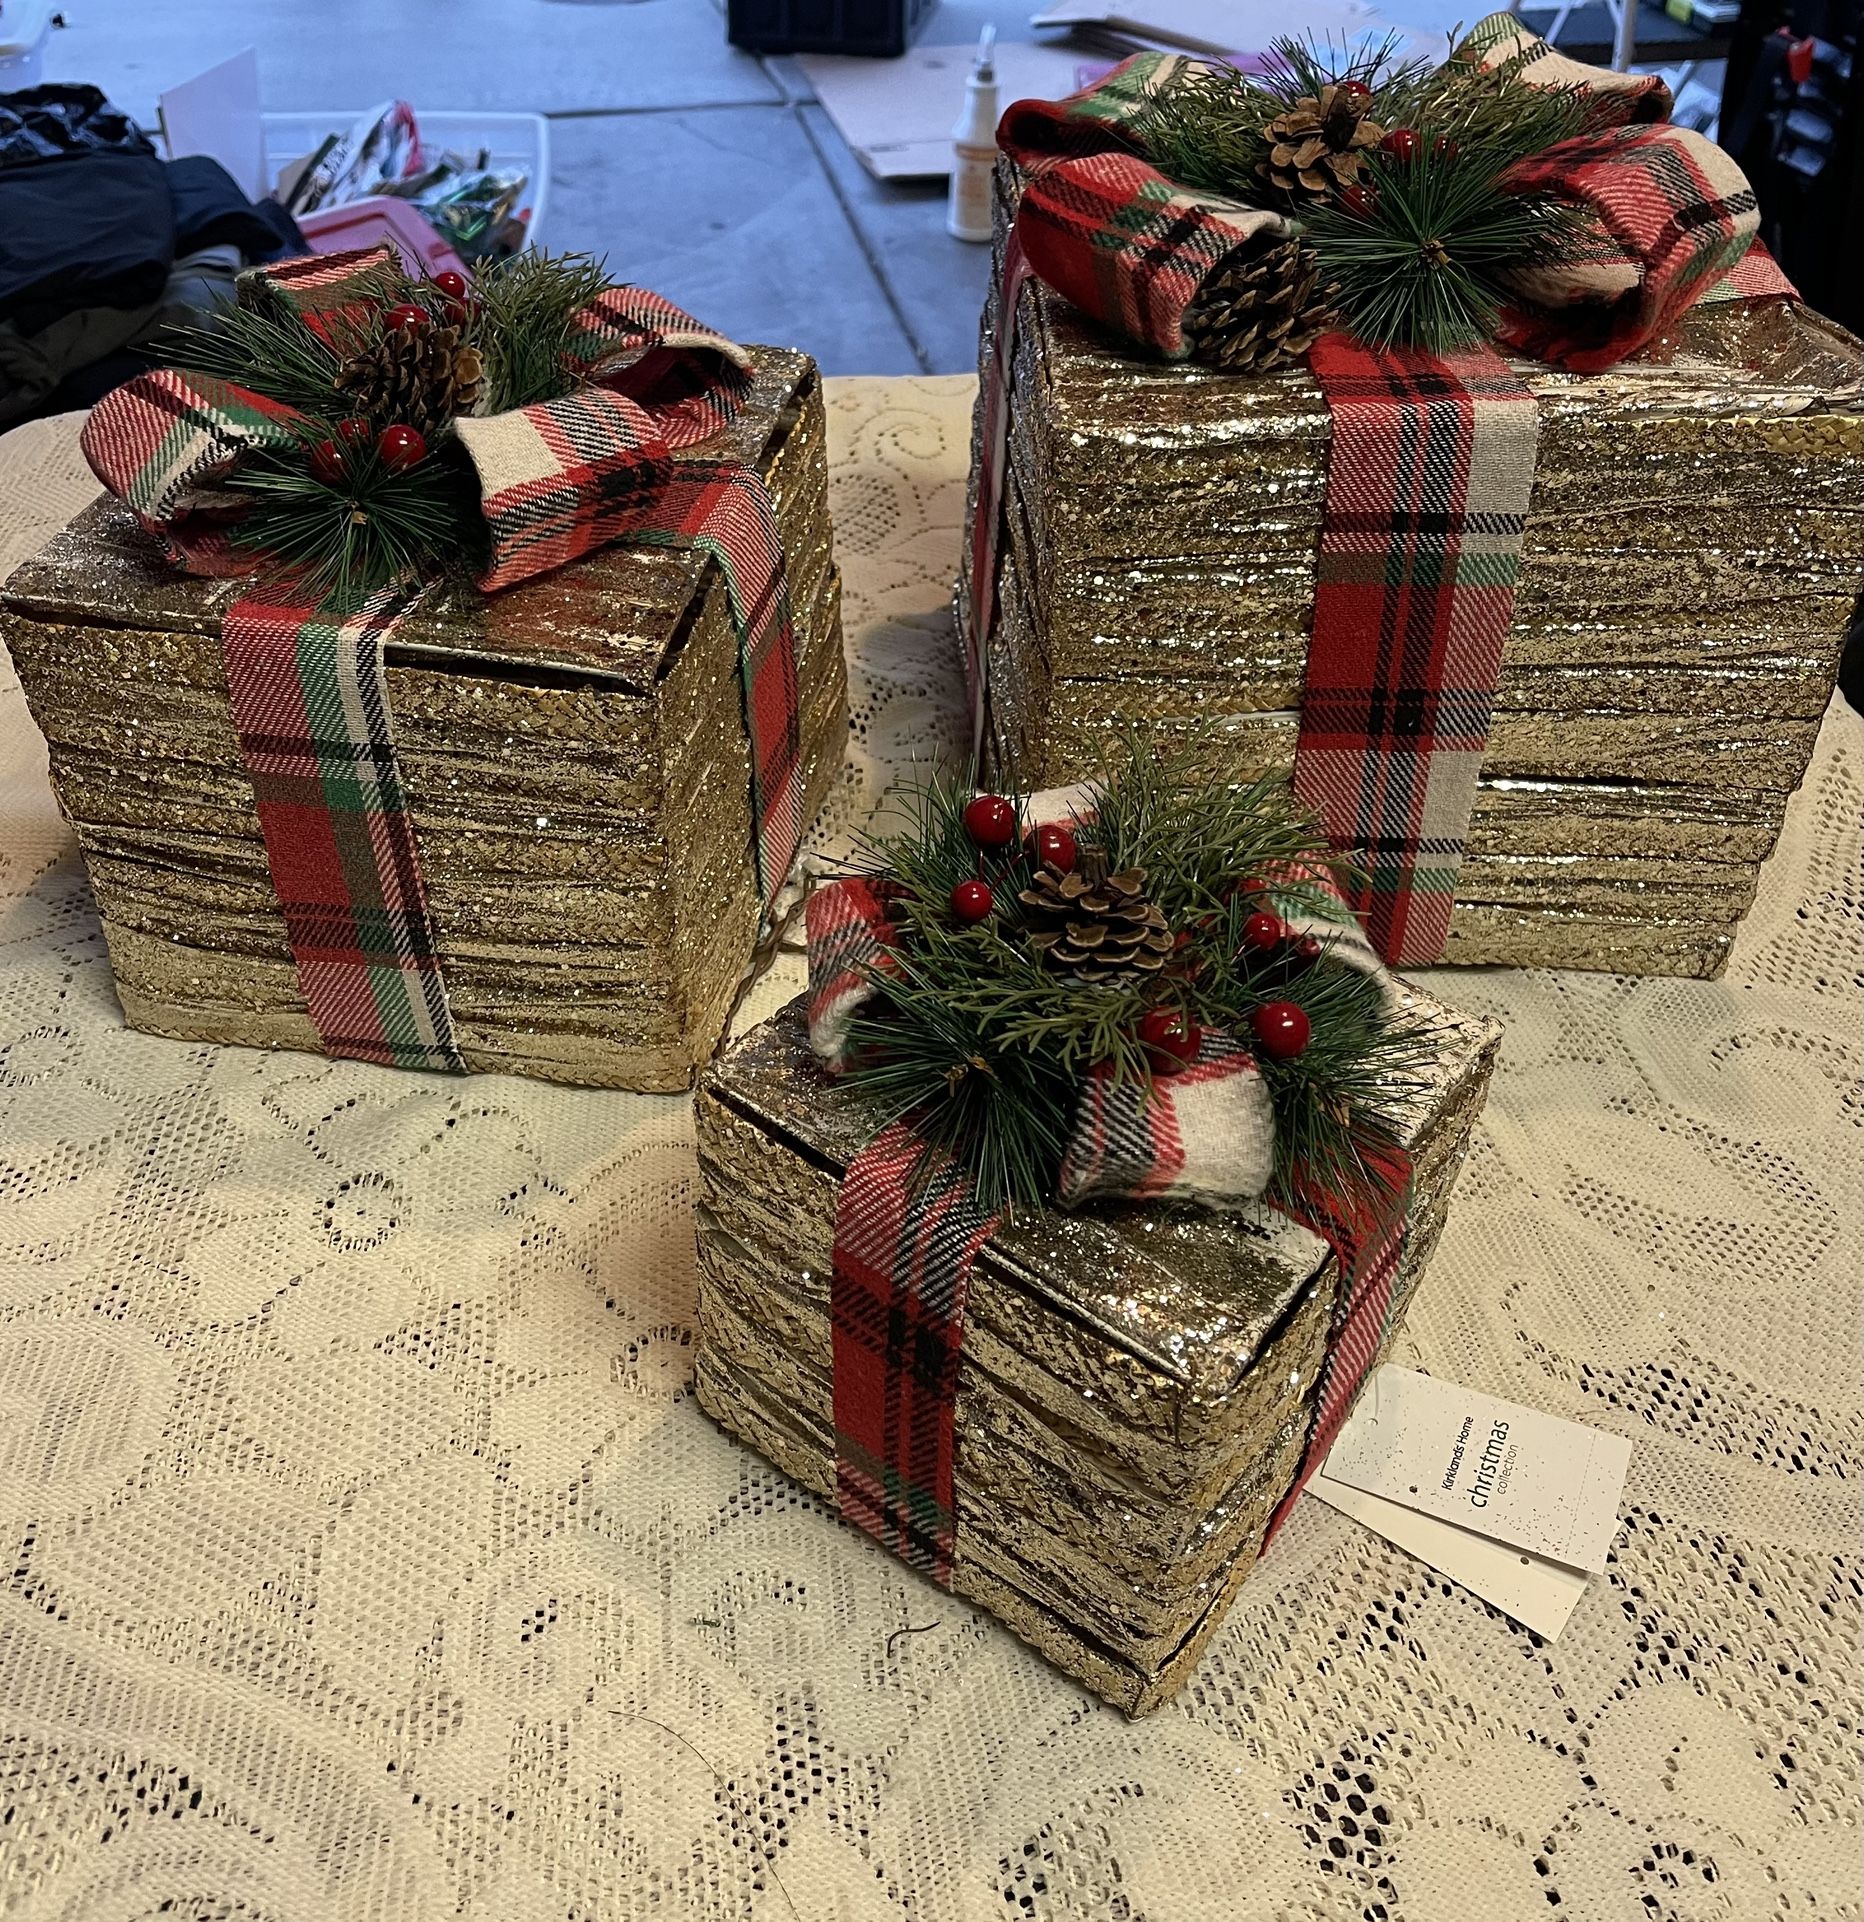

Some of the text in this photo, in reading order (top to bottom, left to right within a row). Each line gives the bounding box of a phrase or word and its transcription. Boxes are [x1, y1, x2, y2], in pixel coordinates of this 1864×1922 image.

[1456, 1416, 1474, 1444] Home
[1466, 1420, 1509, 1508] christmas
[1497, 1444, 1519, 1494] collection
